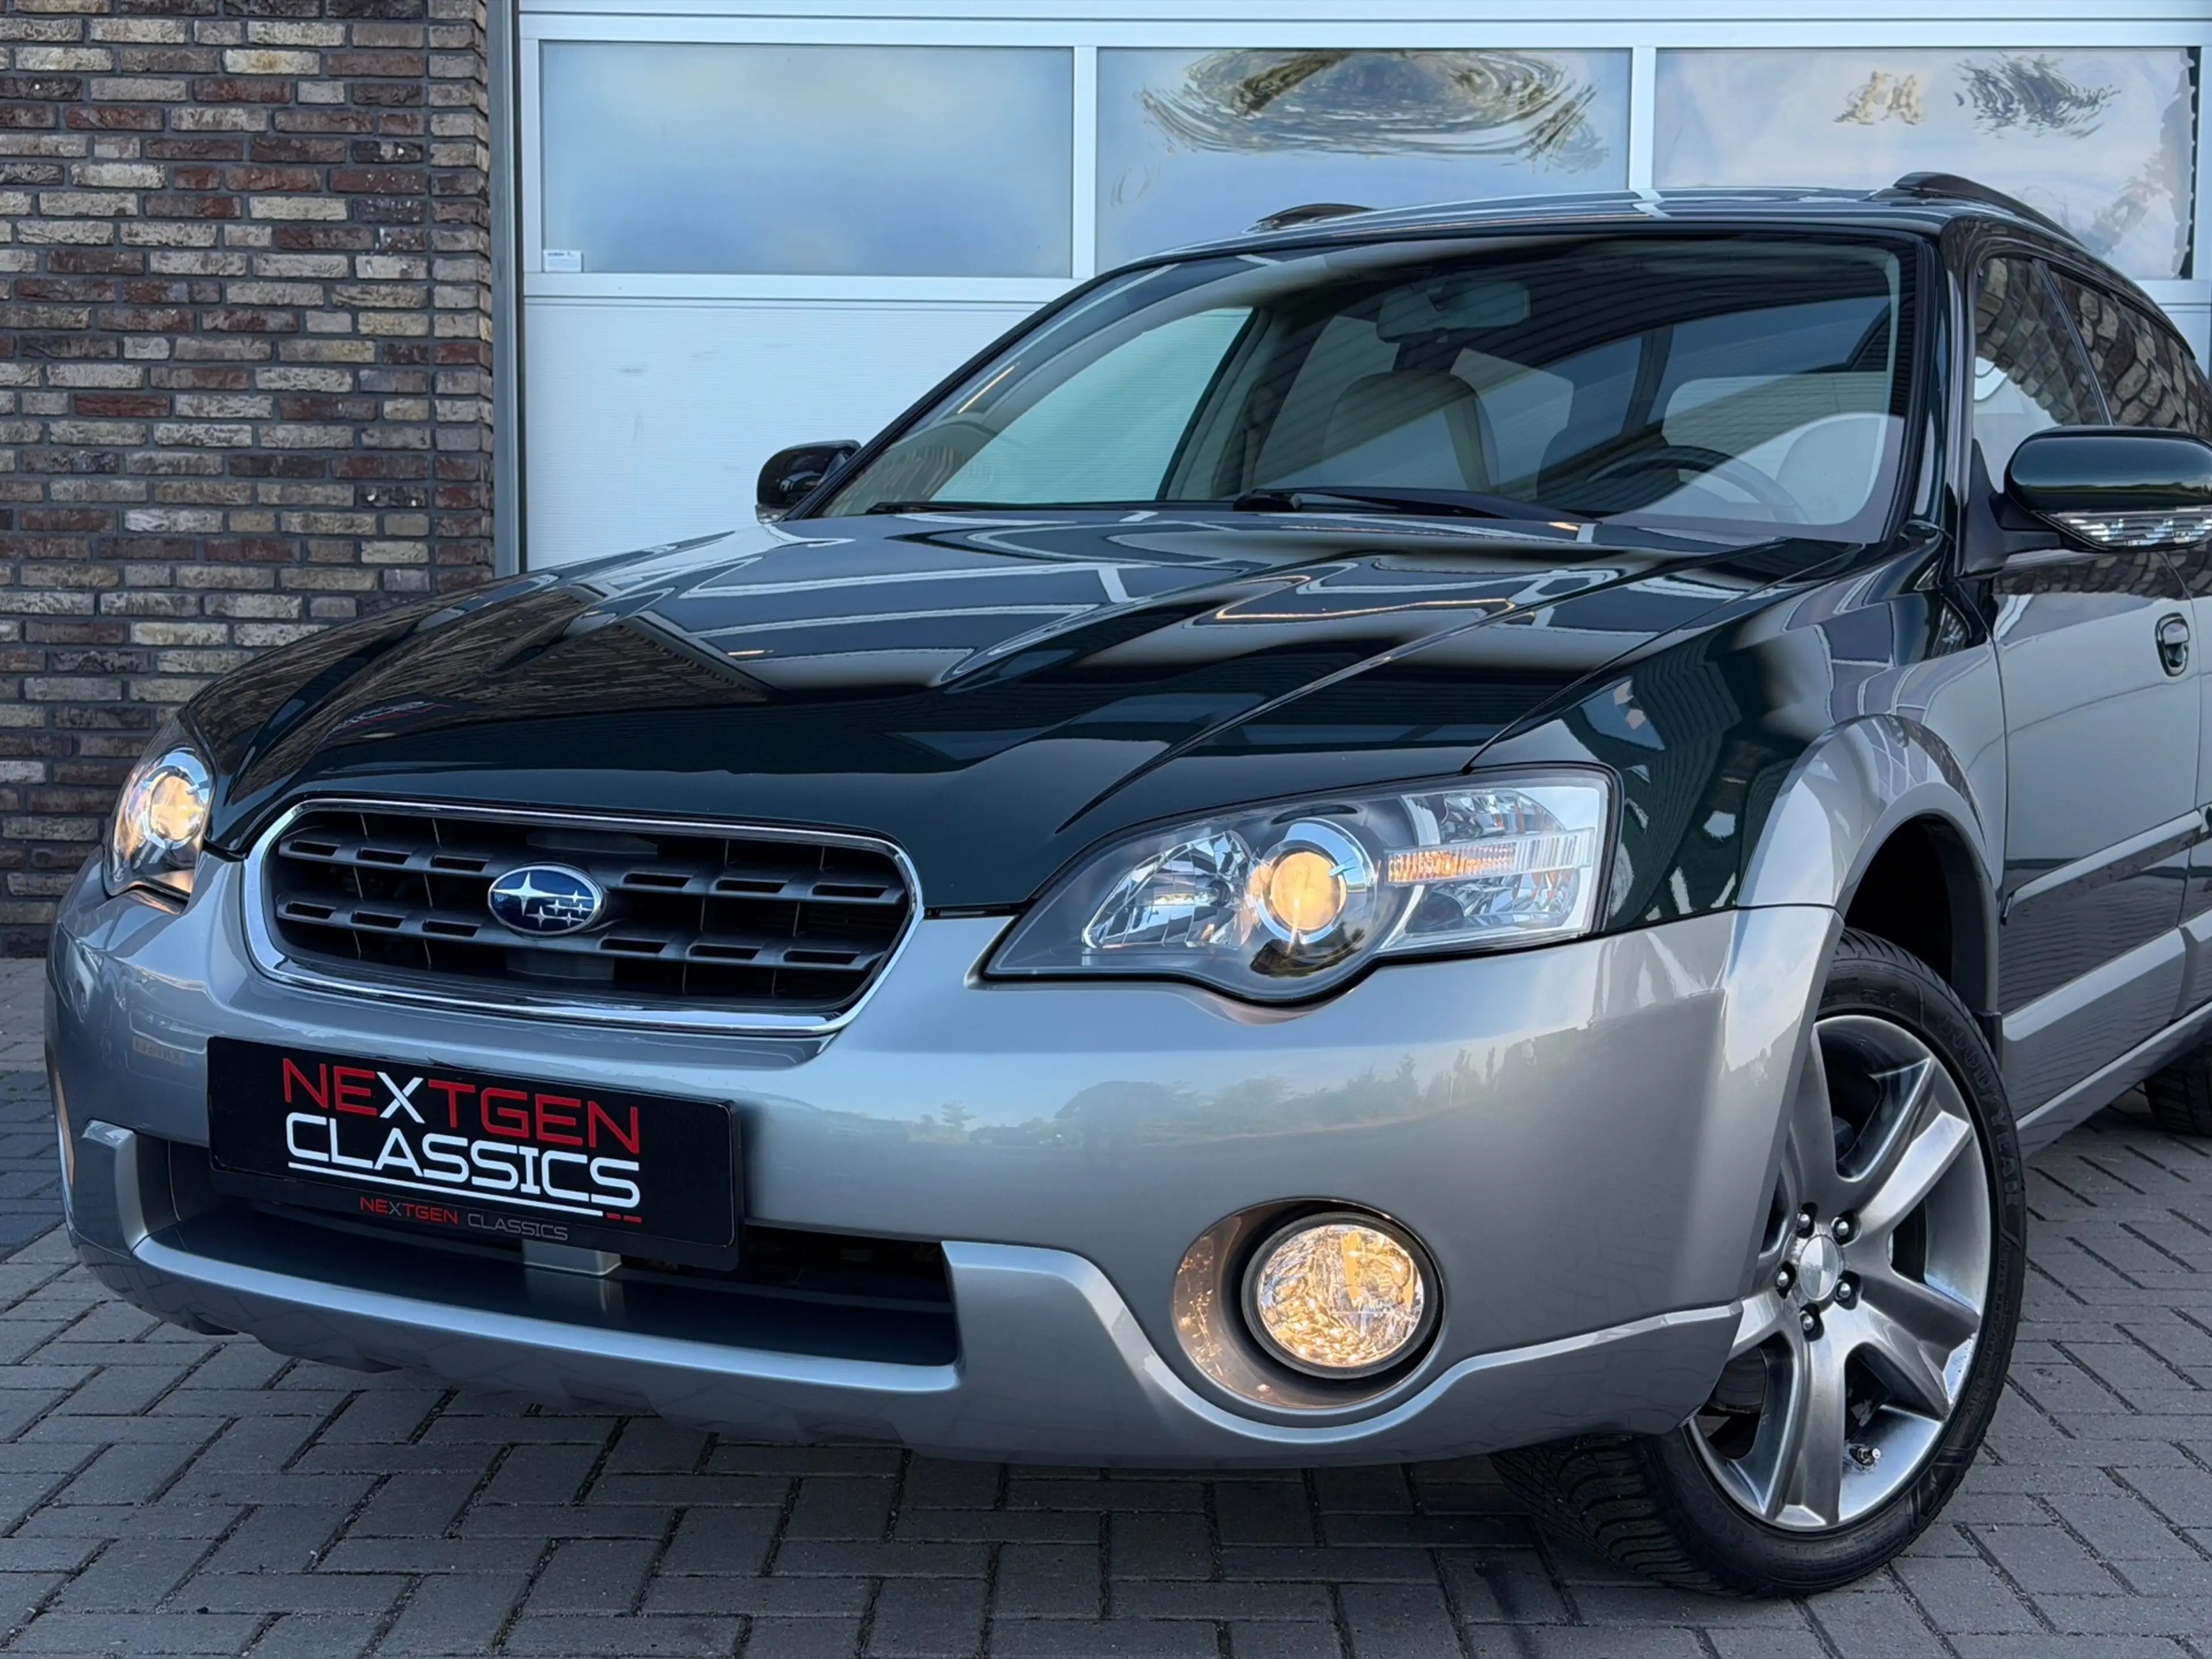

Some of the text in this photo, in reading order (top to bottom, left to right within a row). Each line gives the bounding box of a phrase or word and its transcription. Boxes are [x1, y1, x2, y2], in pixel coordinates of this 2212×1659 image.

[283, 1058, 639, 1154] NEXTGEN
[286, 1112, 641, 1208] CLASSICS
[359, 1197, 568, 1241] NEXTGEN CLASSICS
